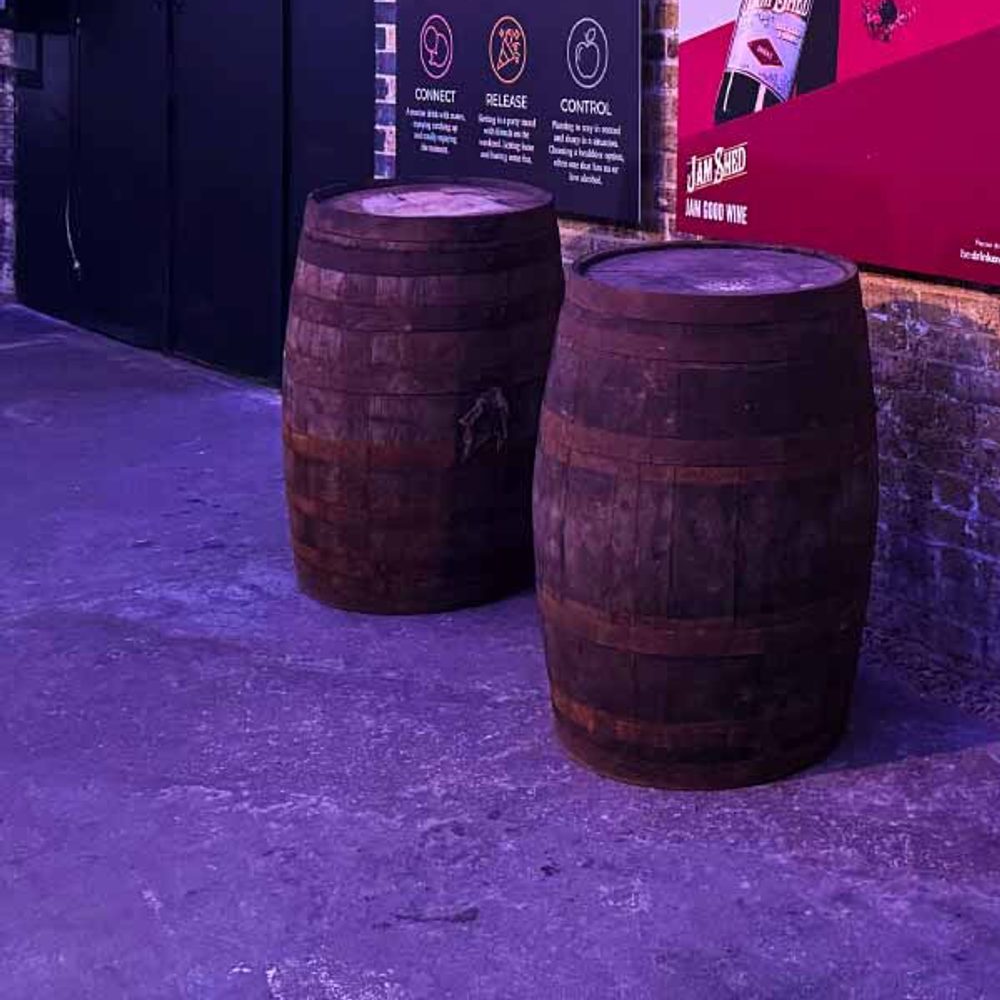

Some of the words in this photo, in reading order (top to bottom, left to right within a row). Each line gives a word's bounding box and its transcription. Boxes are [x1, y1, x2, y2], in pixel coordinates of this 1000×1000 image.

[415, 88, 456, 103] CONNECT
[485, 93, 528, 110] RELEASE
[560, 98, 613, 116] CONTROL
[686, 156, 714, 193] JAM
[713, 146, 747, 185] SHED
[702, 200, 725, 222] GOOD
[725, 203, 748, 225] WINE
